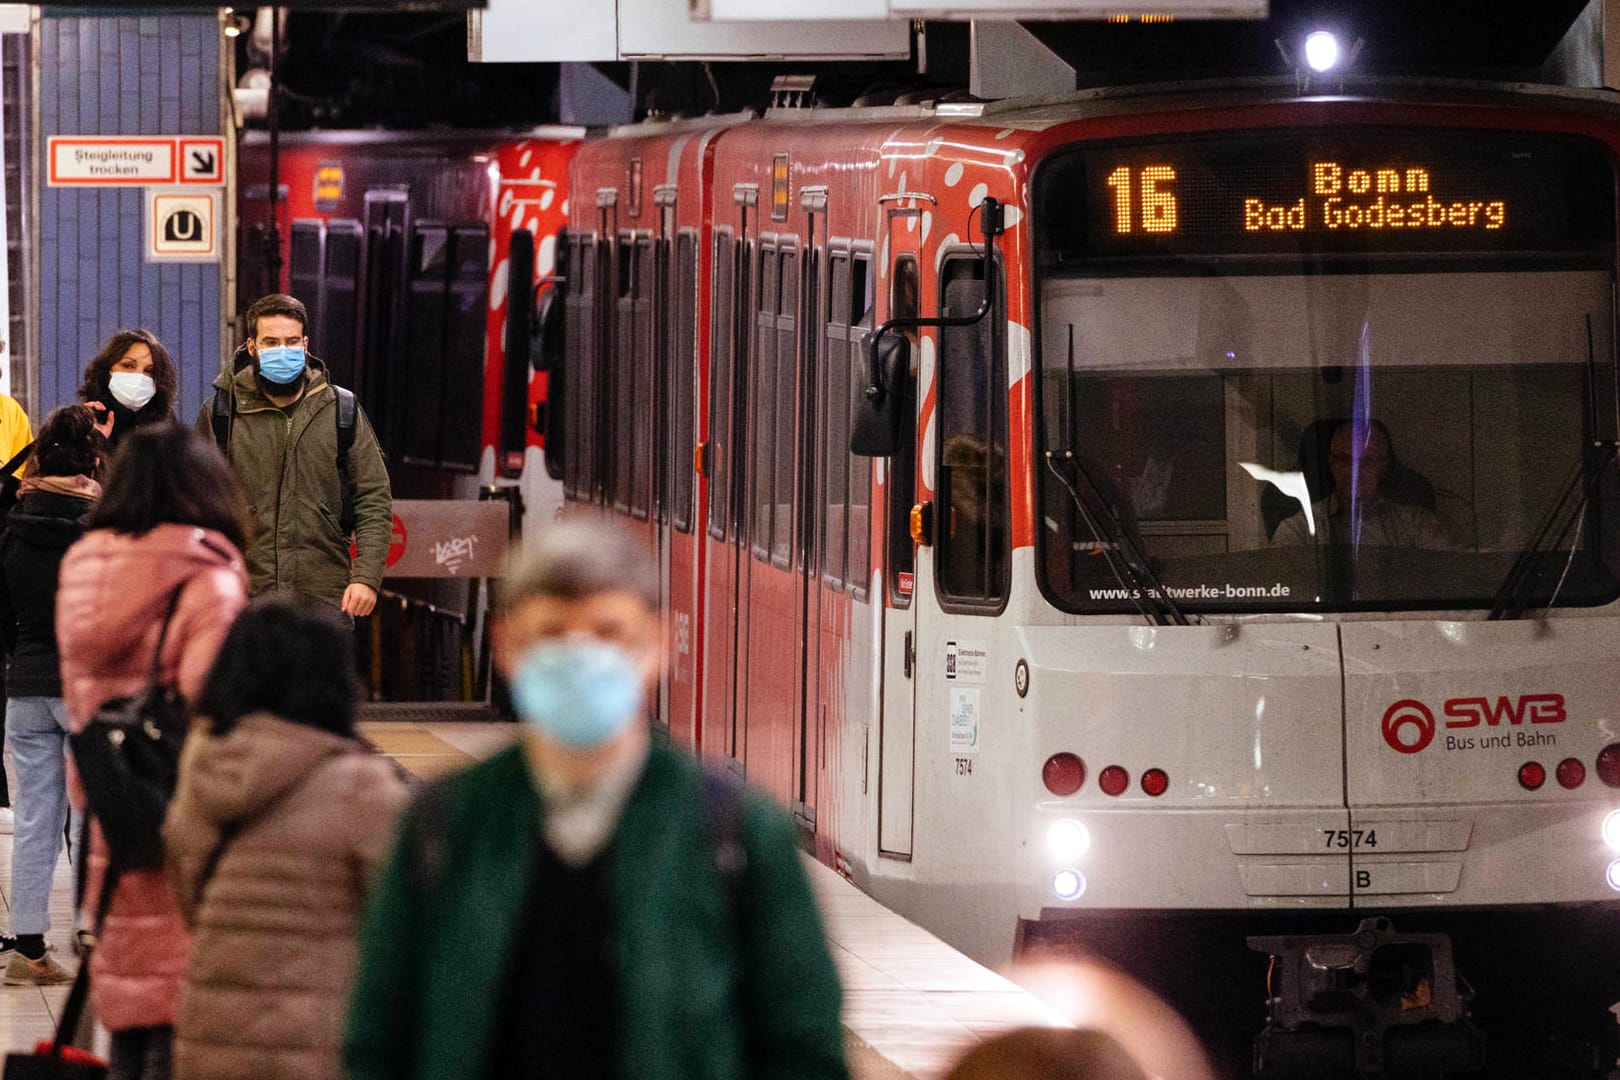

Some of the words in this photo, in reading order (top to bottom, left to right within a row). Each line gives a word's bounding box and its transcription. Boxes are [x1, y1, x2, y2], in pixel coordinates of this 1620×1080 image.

[75, 150, 153, 163] Steigleitung
[90, 165, 139, 175] trocken
[1314, 162, 1429, 194] Bonn
[1108, 166, 1177, 233] 16
[1245, 198, 1305, 231] Bad
[1323, 195, 1505, 230] Godesberg
[172, 213, 195, 239] U
[1444, 694, 1566, 729] SWB
[1446, 735, 1475, 751] Bus
[1480, 732, 1511, 749] und
[1516, 732, 1556, 747] Bahn
[955, 758, 972, 776] 7574
[1324, 830, 1377, 848] 7574
[1356, 871, 1371, 888] B
